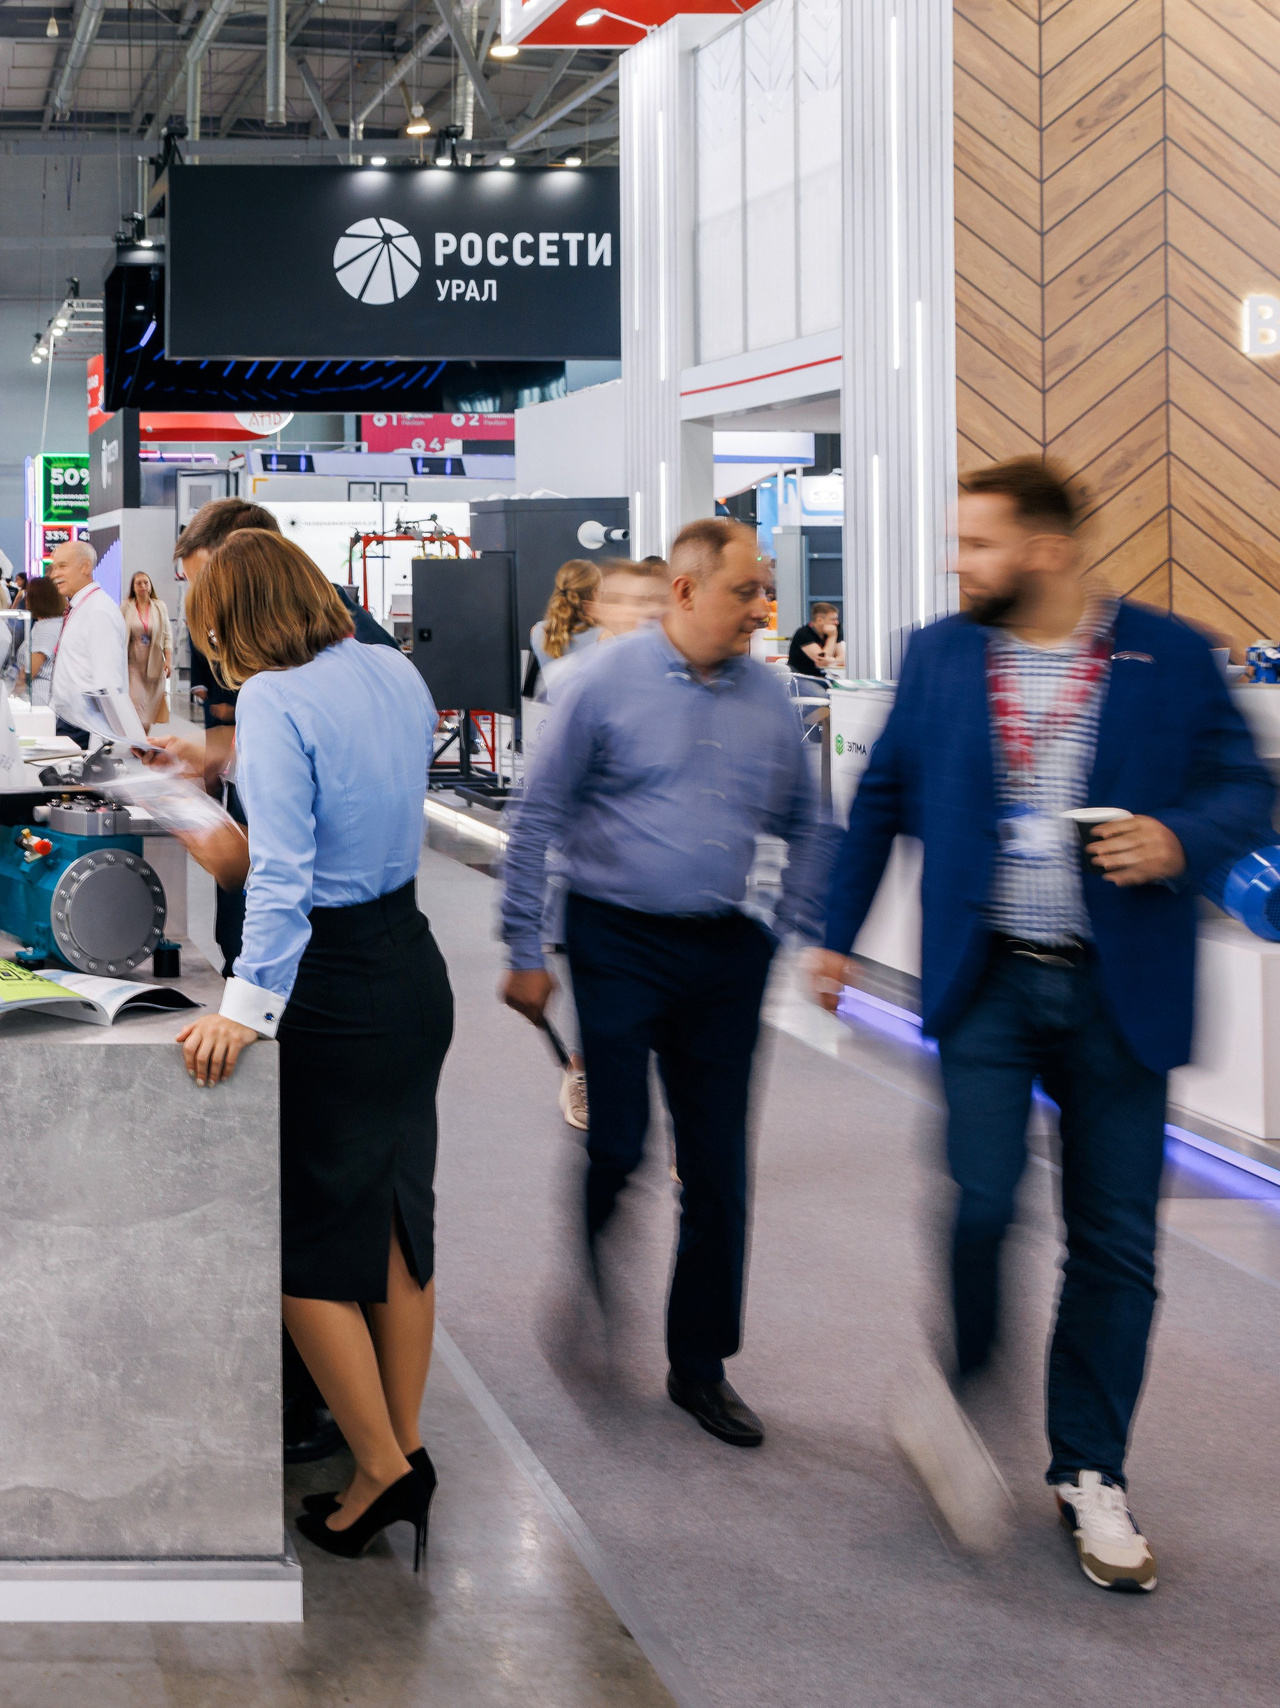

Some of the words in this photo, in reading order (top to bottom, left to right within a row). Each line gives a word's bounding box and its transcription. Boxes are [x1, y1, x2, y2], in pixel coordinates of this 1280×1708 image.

[435, 232, 612, 267] РОССЕТИ
[435, 279, 497, 302] УРАЛ
[429, 438, 441, 450] 4
[45, 530, 69, 541] 33%
